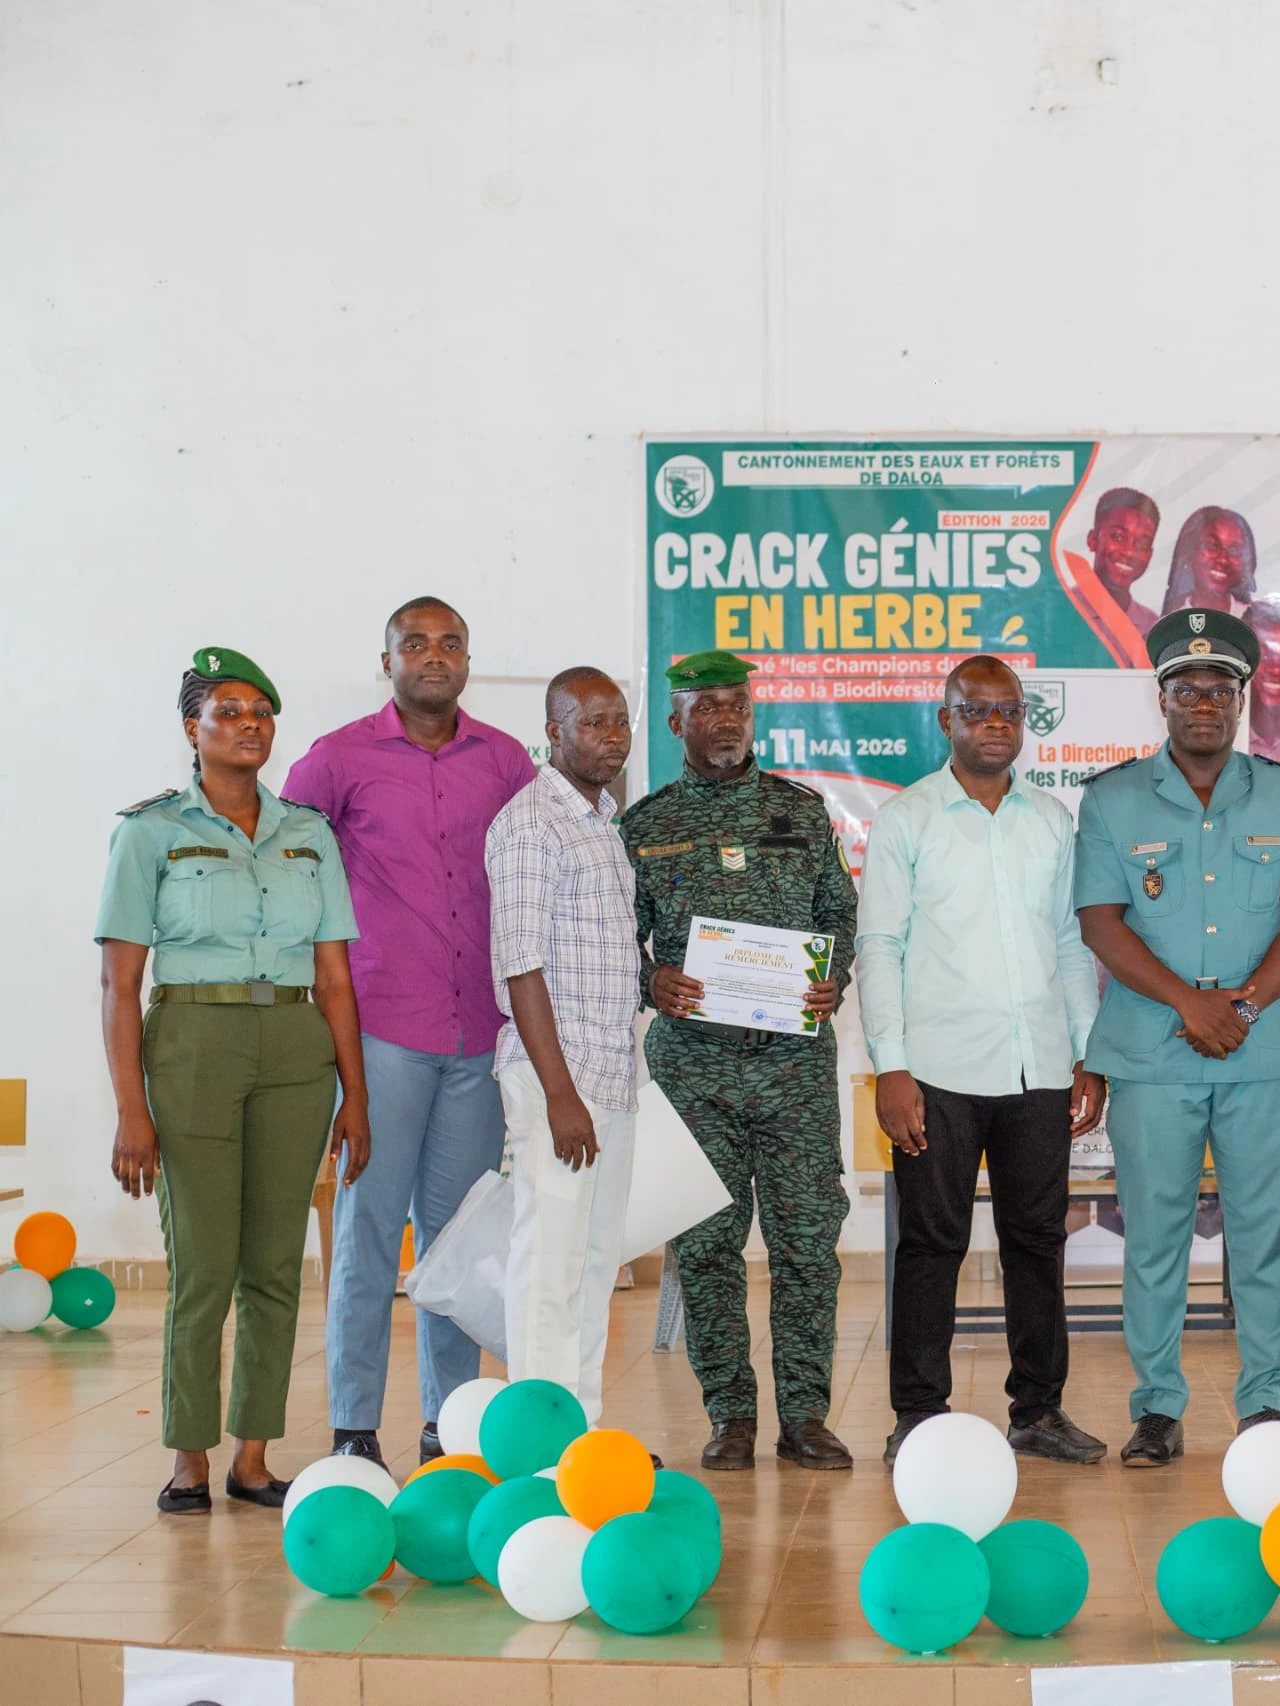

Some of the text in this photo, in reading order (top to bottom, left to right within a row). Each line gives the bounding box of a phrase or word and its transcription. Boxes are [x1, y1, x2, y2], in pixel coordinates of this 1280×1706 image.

[738, 451, 1061, 469] CANTONNEMENT DES EAUX ET FORÊTS
[860, 471, 944, 485] DE DALOA
[942, 511, 1047, 526] ÉDITION 2026
[654, 517, 1042, 590] CRACK GÉNIES
[715, 594, 982, 650] EN HERBE
[822, 658, 932, 677] Champions
[755, 681, 945, 698] et de la Biodiversité
[768, 728, 806, 764] 11
[810, 740, 851, 757] MAI
[856, 738, 907, 756] 2026
[1038, 743, 1057, 763] La
[1061, 742, 1137, 763] Direction
[1025, 768, 1056, 788] des
[1083, 1143, 1113, 1153] DALO
